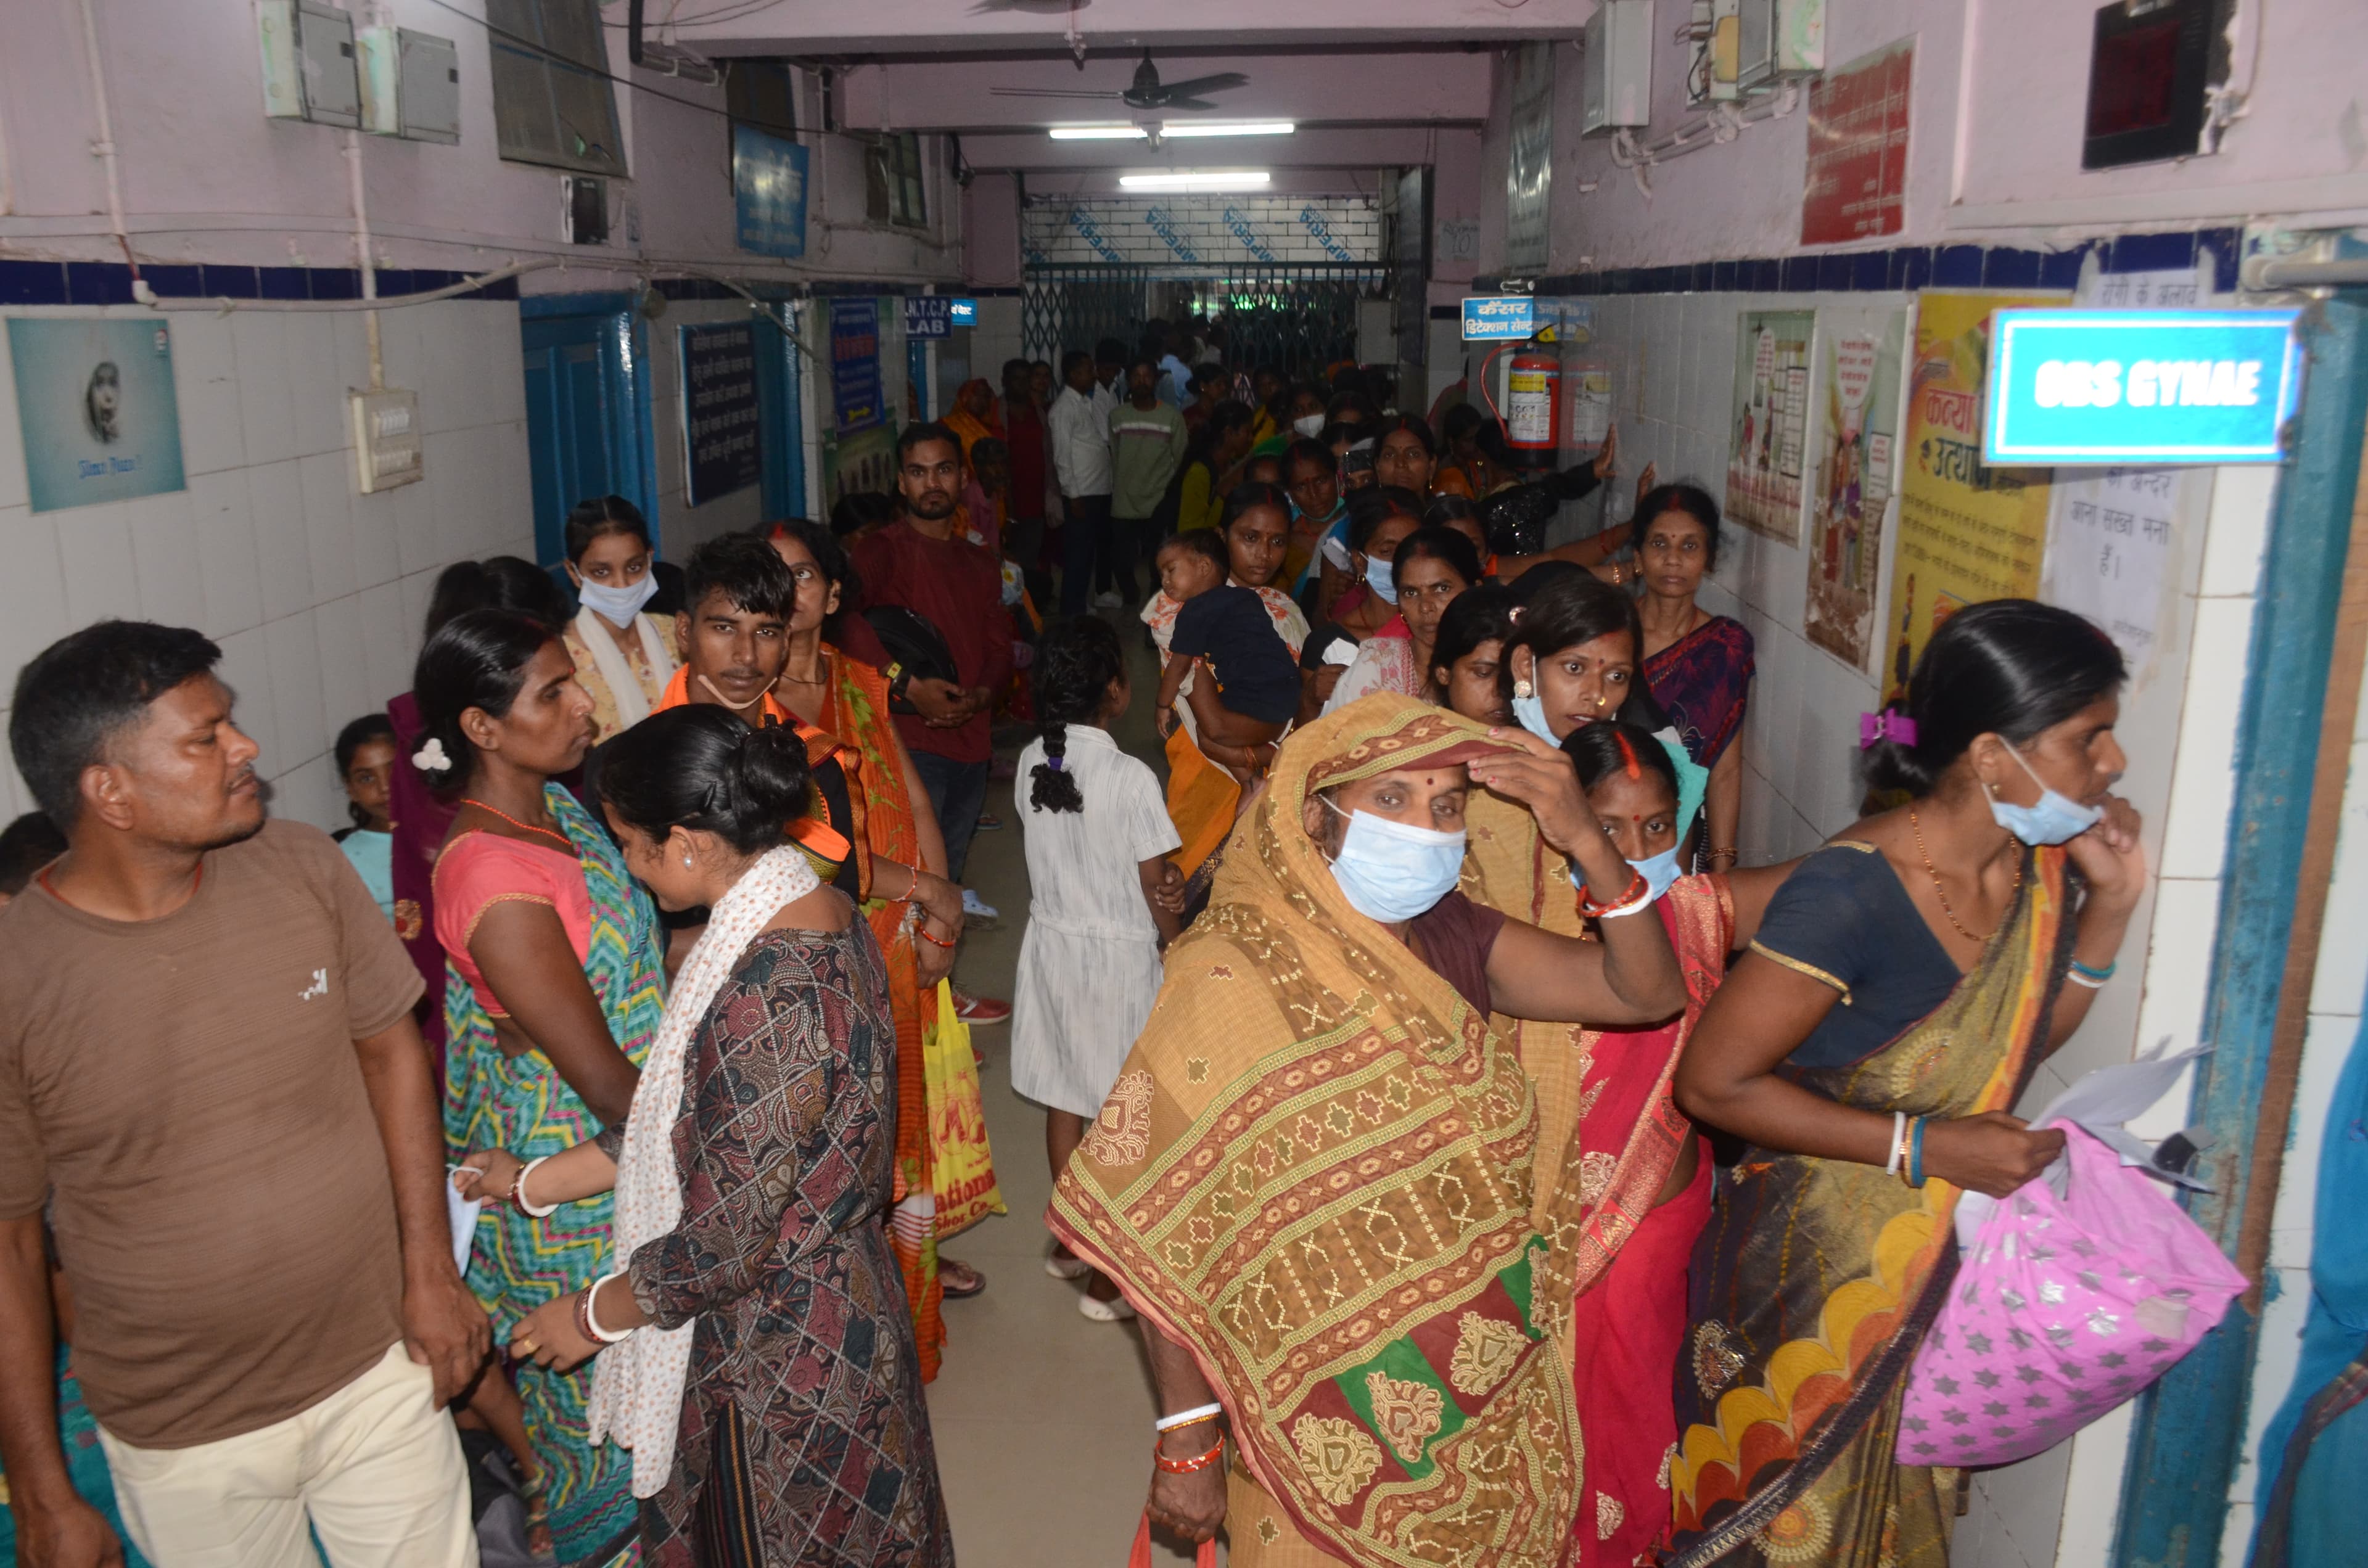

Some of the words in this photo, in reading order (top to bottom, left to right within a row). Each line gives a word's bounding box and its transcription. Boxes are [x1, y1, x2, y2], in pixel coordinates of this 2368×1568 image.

[906, 319, 945, 334] LAB
[2035, 359, 2122, 408] OBS
[1926, 387, 1978, 435] कन्या
[2142, 517, 2171, 546] मना
